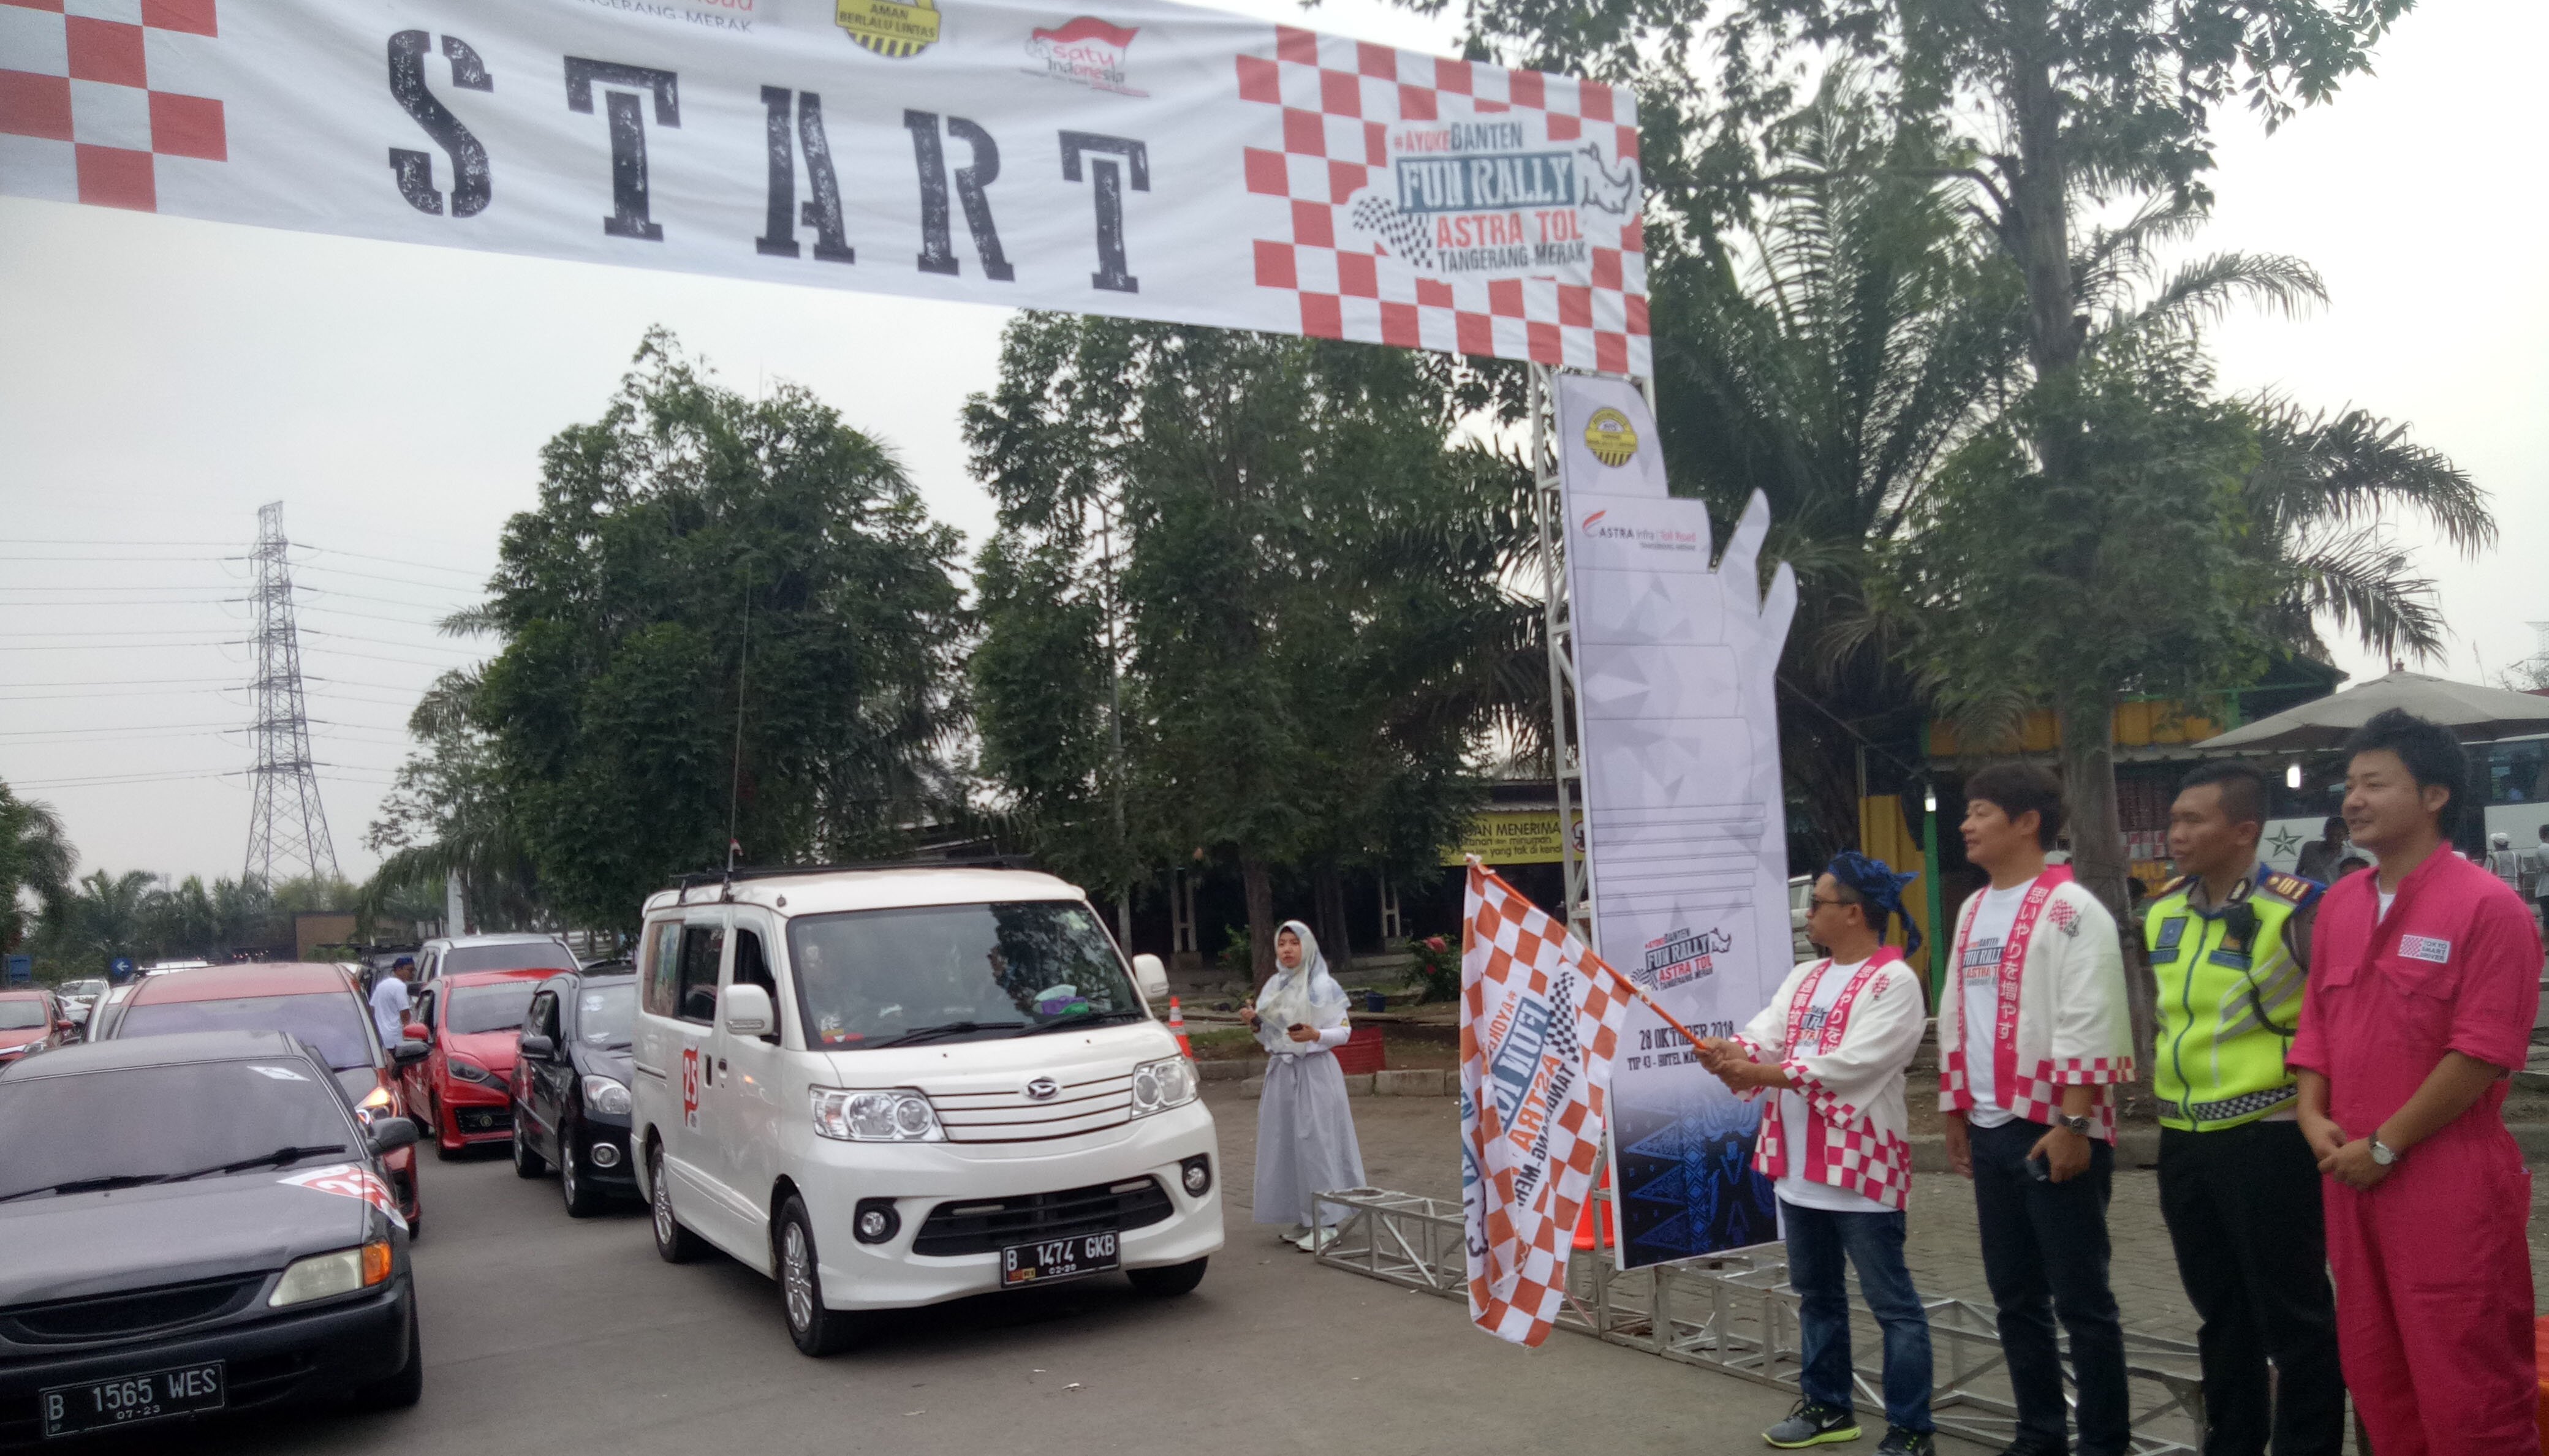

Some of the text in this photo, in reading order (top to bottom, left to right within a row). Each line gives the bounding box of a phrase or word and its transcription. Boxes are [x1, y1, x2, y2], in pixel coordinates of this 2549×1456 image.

[388, 28, 1150, 293] START
[1398, 156, 1572, 209] FUN RALLY
[1437, 209, 1584, 249] ASTRA TOL
[1599, 527, 1634, 540] ASTRA
[1496, 821, 1561, 836] MENERIMA
[1509, 836, 1551, 845] minuman
[1490, 847, 1512, 858] yang
[1647, 935, 1709, 971] FUN RALLY
[2422, 946, 2445, 955] SMART
[2424, 940, 2447, 949] TOKYO
[1659, 955, 1713, 982] ASTRA TOL
[1966, 967, 1991, 979] ASTRA
[1639, 1029, 1653, 1050] 28
[1711, 1020, 1735, 1043] 2018
[1627, 1056, 1641, 1071] TIP
[1643, 1055, 1651, 1068] 43
[1657, 1052, 1682, 1068] HOTEL
[684, 1057, 697, 1104] 25
[1007, 1234, 1115, 1271] B 1474 GKB
[48, 1368, 217, 1421] B 1565 WES
